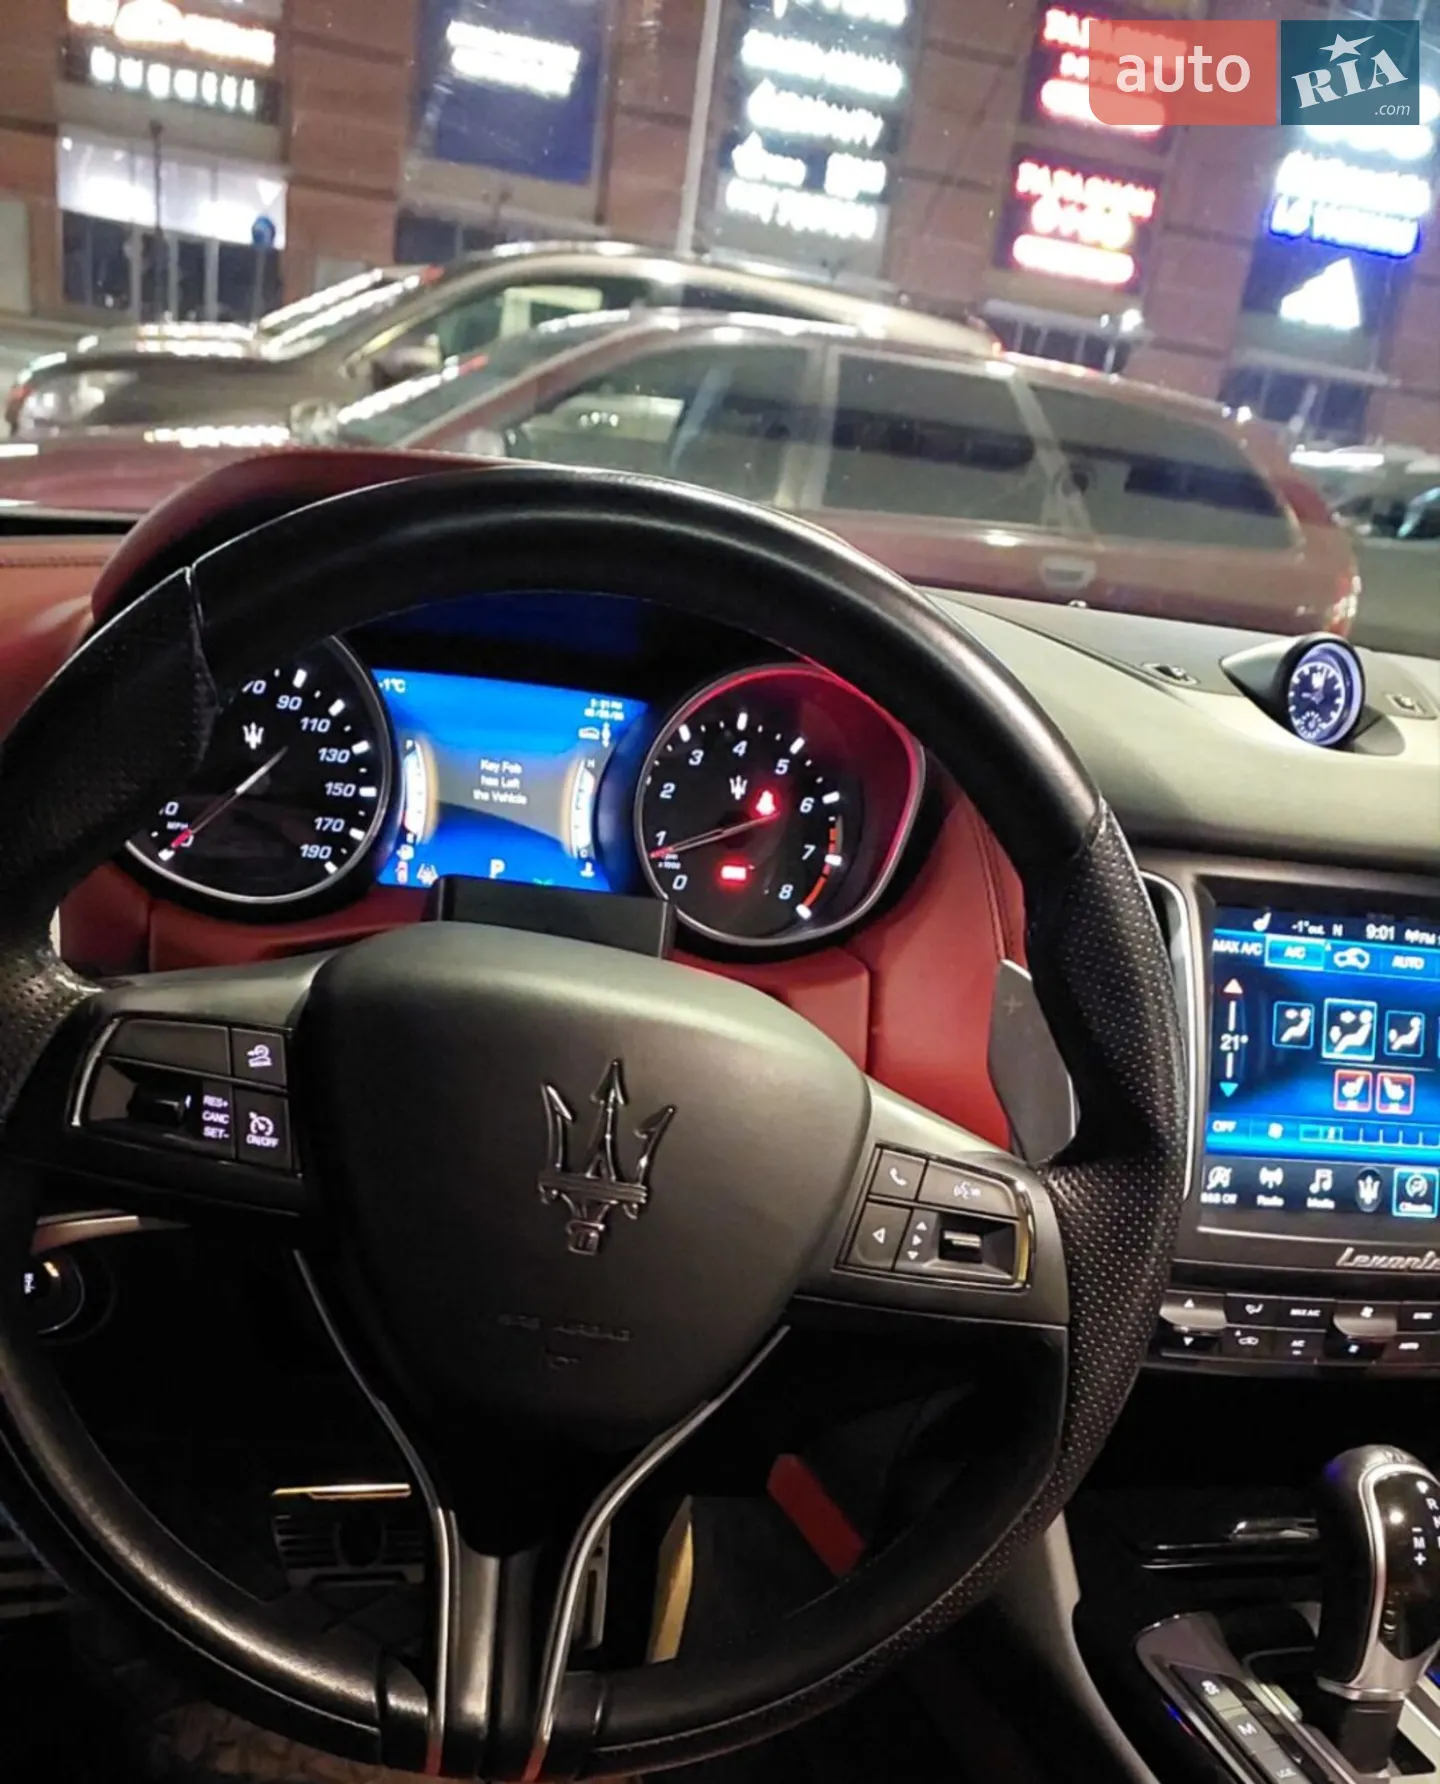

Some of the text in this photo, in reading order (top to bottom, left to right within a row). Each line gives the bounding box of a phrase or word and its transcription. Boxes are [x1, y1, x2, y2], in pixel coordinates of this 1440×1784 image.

[276, 695, 303, 711] 90
[300, 716, 331, 733] 110
[318, 747, 350, 763] 130
[733, 740, 748, 756] 4
[688, 749, 704, 766] 3
[775, 758, 790, 775] 5
[325, 781, 356, 798] 150
[660, 783, 676, 799] 2
[800, 797, 814, 813] 6
[314, 816, 345, 832] 170
[655, 830, 667, 847] 1
[300, 843, 332, 859] 190
[802, 844, 815, 860] 7
[489, 858, 506, 879] P
[672, 874, 688, 890] 0
[779, 884, 794, 900] 8
[1332, 923, 1344, 937] N
[1366, 923, 1396, 941] 9:01
[1212, 939, 1240, 954] MAX
[1391, 955, 1425, 970] AUTO
[202, 1110, 230, 1125] CANC
[1426, 1497, 1440, 1511] R
[1237, 1722, 1258, 1736] M
